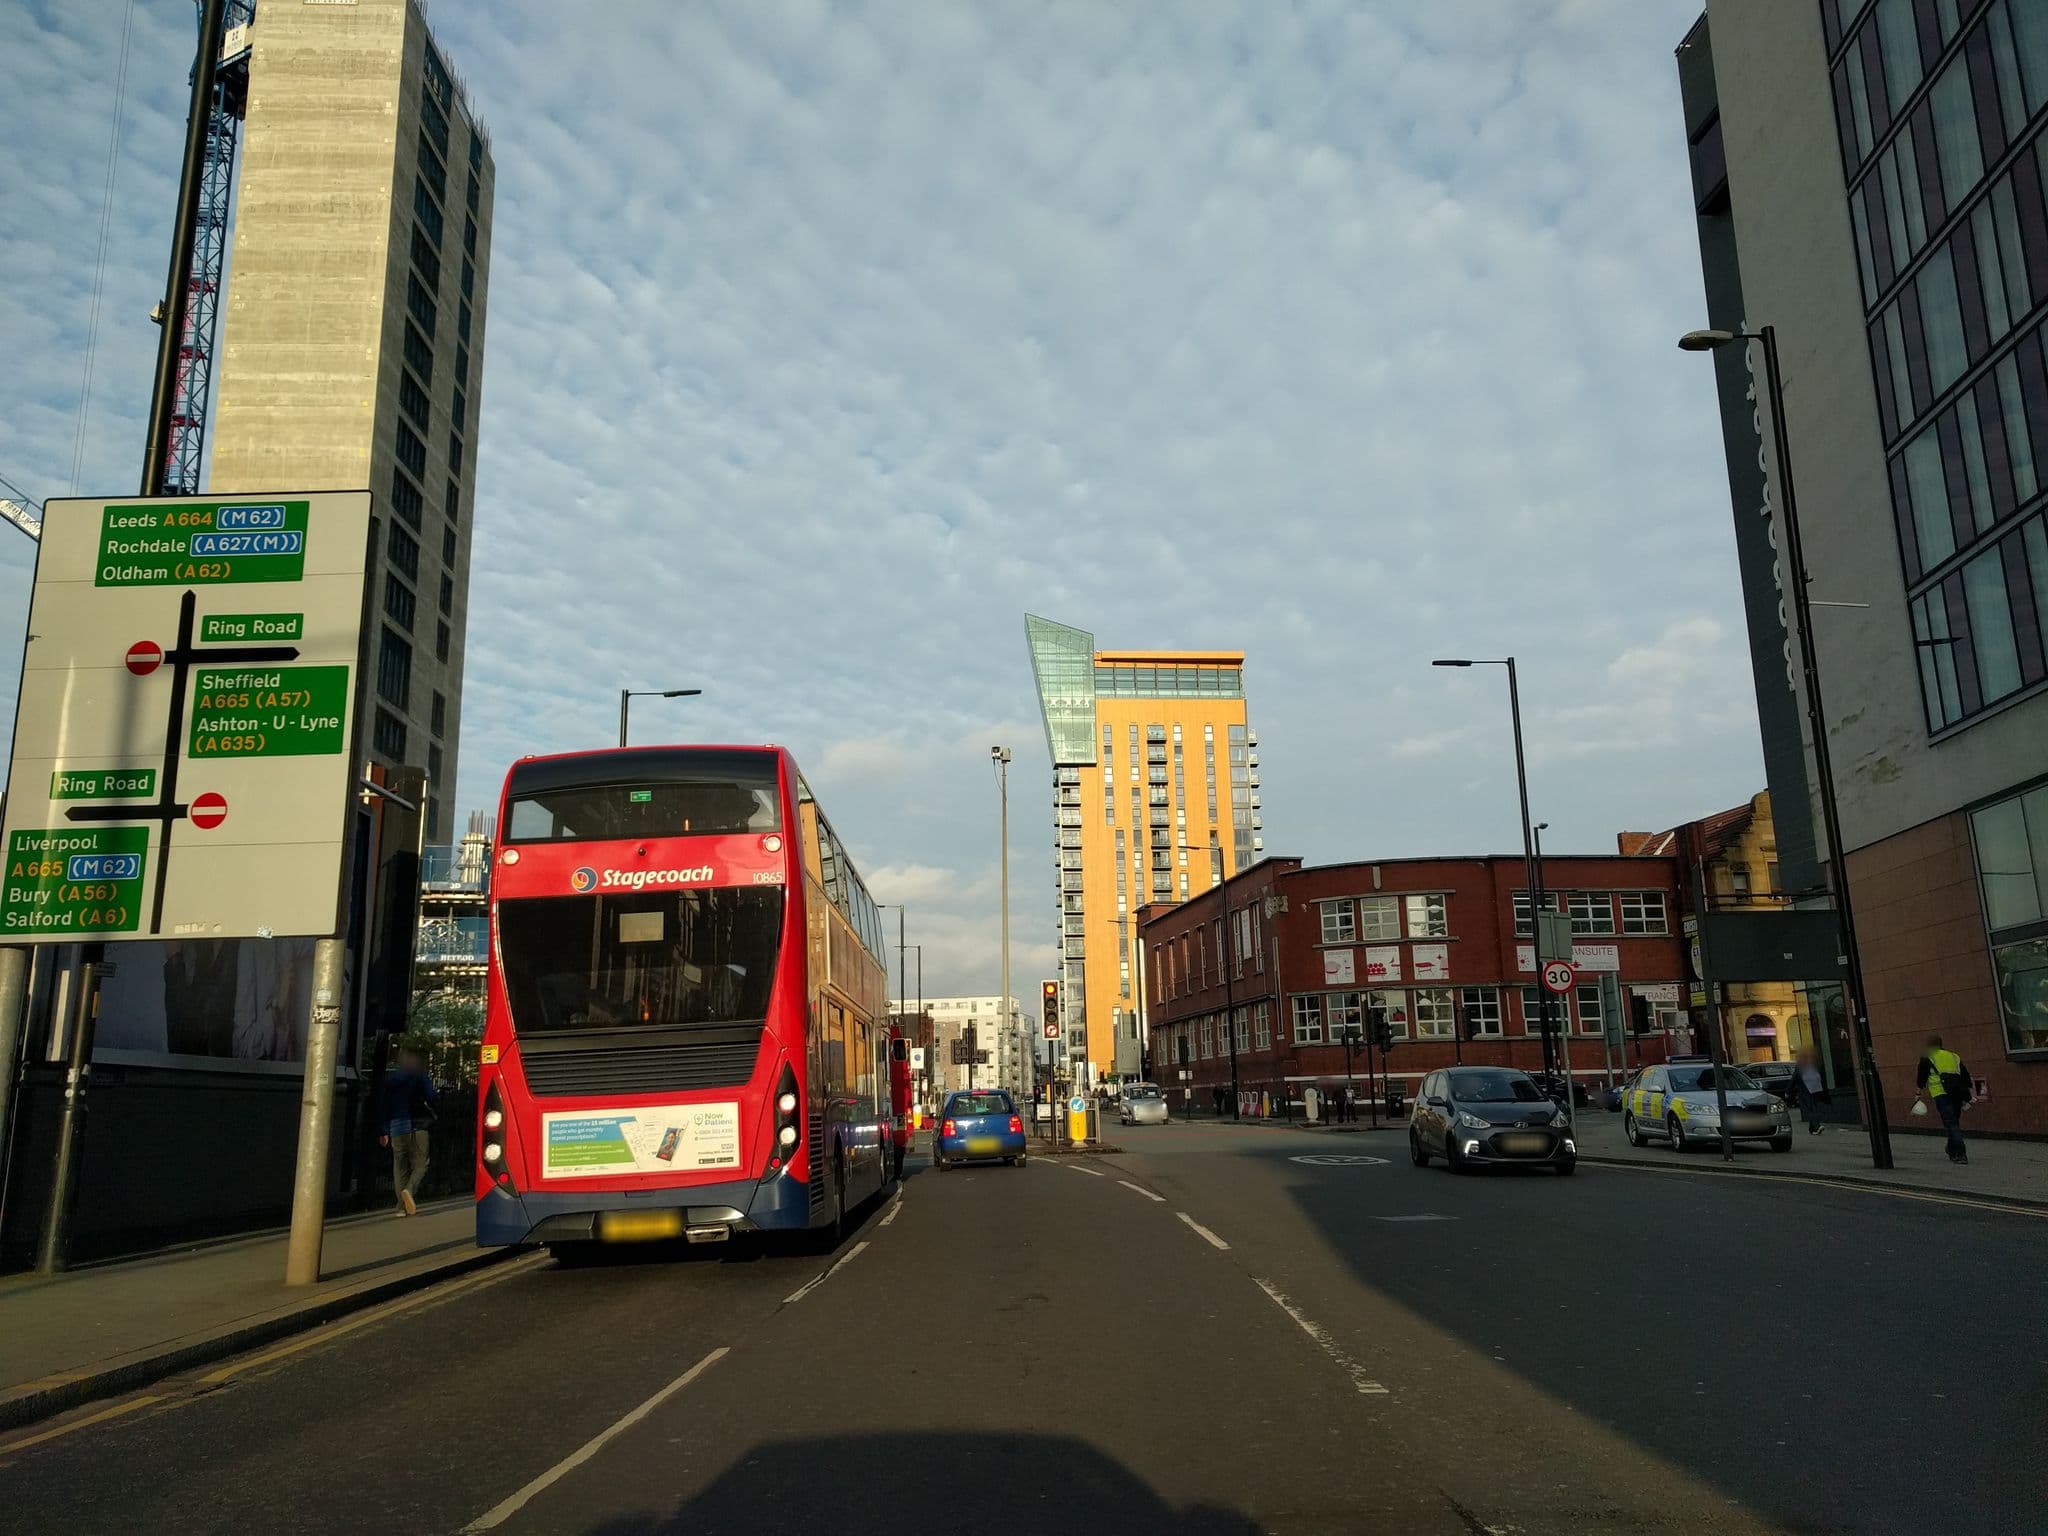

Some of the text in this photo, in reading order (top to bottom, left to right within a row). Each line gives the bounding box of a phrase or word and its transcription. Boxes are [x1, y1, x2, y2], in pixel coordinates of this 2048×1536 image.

[110, 508, 282, 528] Leeds A664 (M62)
[108, 534, 299, 554] Rochdale (A627(M))
[103, 563, 230, 580] Oldham (A62)
[209, 620, 296, 636] Ring Road
[203, 674, 279, 689] Sheffield
[201, 691, 310, 708] A665 (A57)
[197, 735, 264, 752] (A635)
[58, 776, 147, 795] Ring Road
[17, 835, 97, 852] Liverpool
[12, 858, 138, 879] A665 (M62)
[602, 865, 714, 889] Stagecoach
[753, 871, 783, 884] 10865
[10, 884, 117, 904] Bury (A56)
[6, 909, 125, 926] Salford (A6)
[1573, 947, 1613, 955] ANSUITE
[1548, 970, 1570, 984] 30
[705, 1112, 723, 1120] Now
